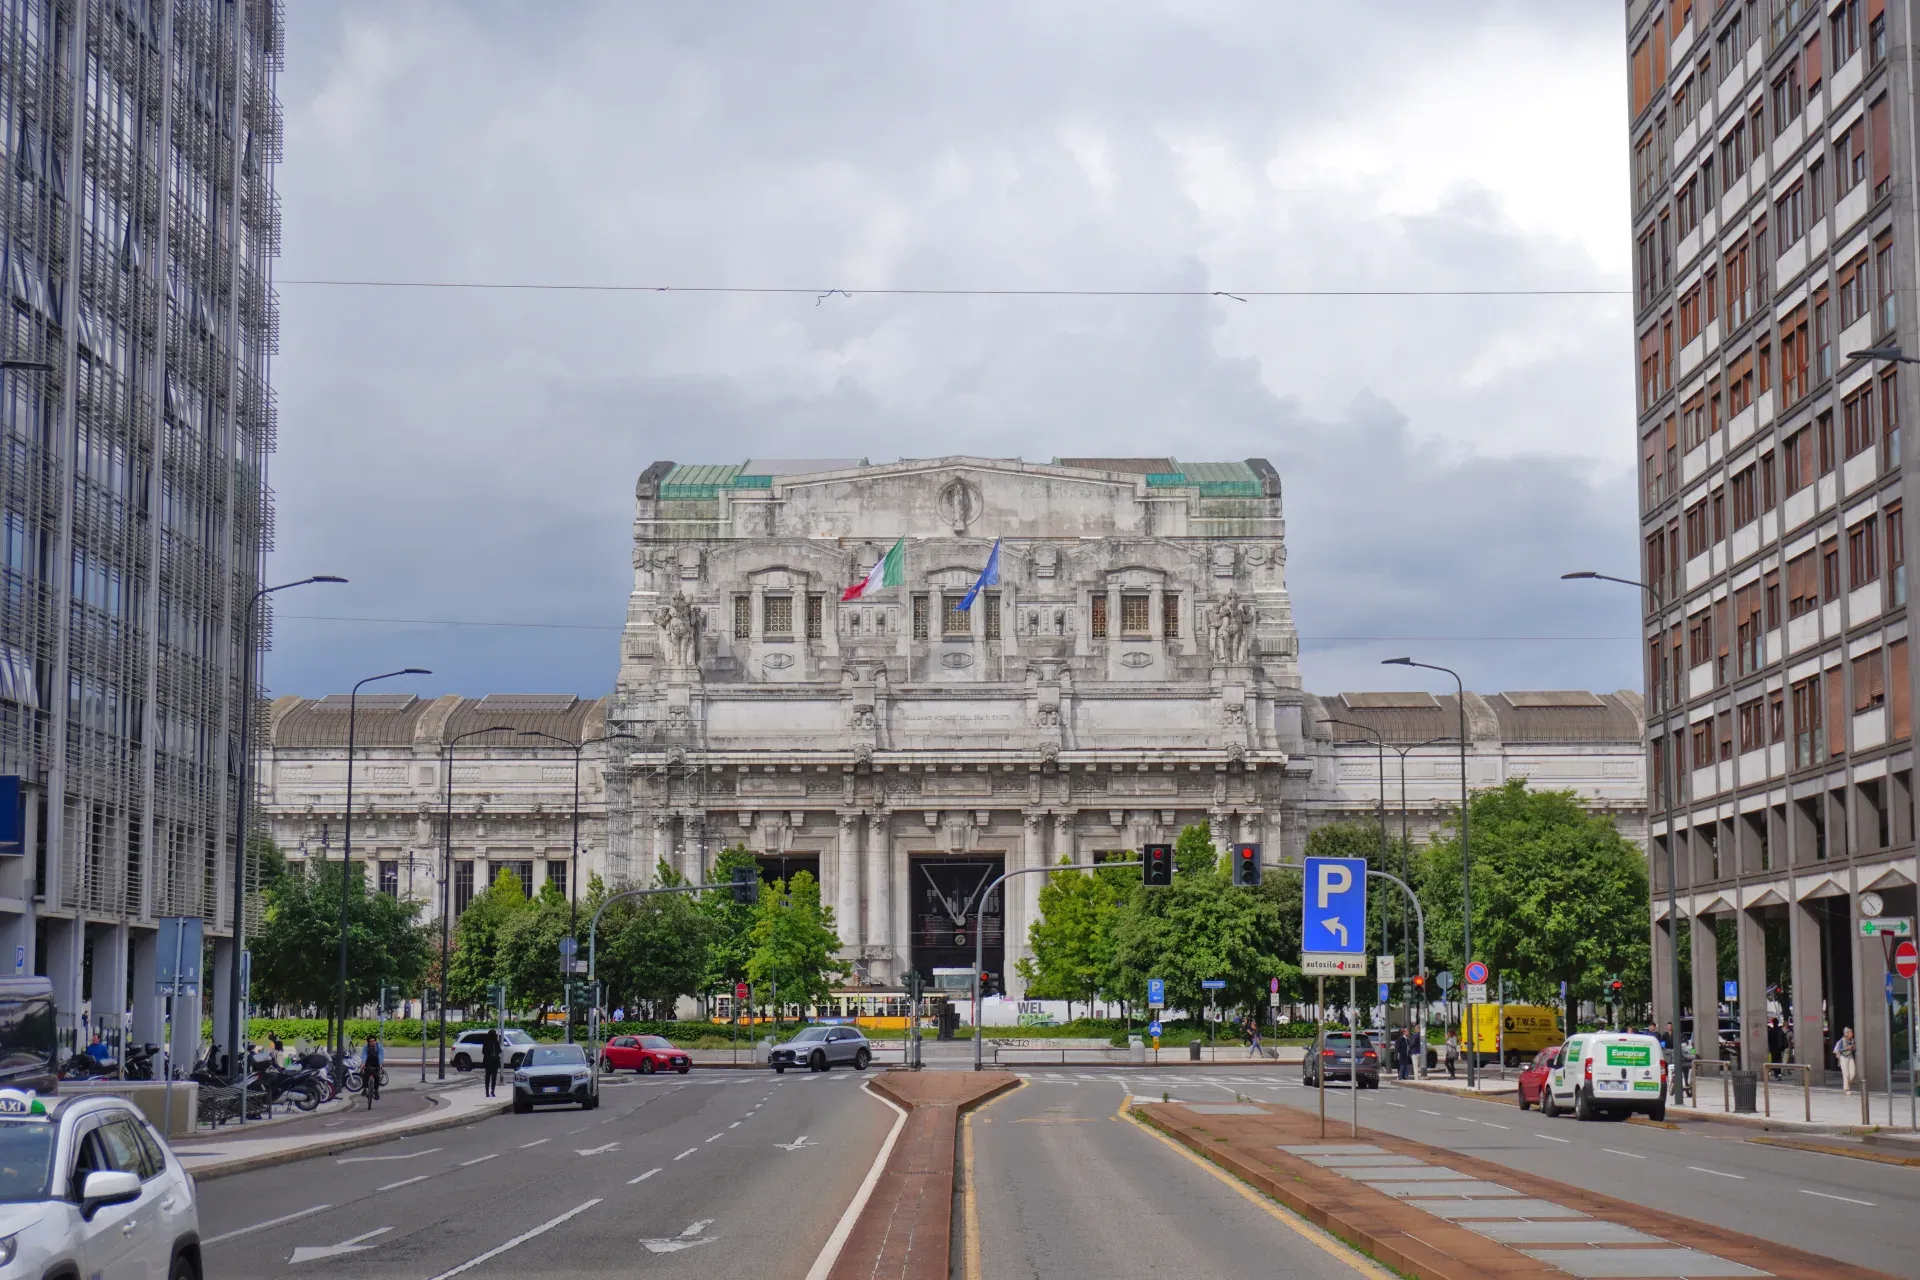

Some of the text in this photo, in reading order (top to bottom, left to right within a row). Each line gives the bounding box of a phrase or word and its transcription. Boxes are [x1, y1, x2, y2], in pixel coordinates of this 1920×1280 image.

[1318, 864, 1352, 908] P
[1152, 982, 1160, 992] P
[1017, 1002, 1045, 1014] WEL
[1516, 1017, 1538, 1027] T.W.S.
[1611, 1049, 1647, 1059] Europcar
[0, 1101, 21, 1111] AXI
